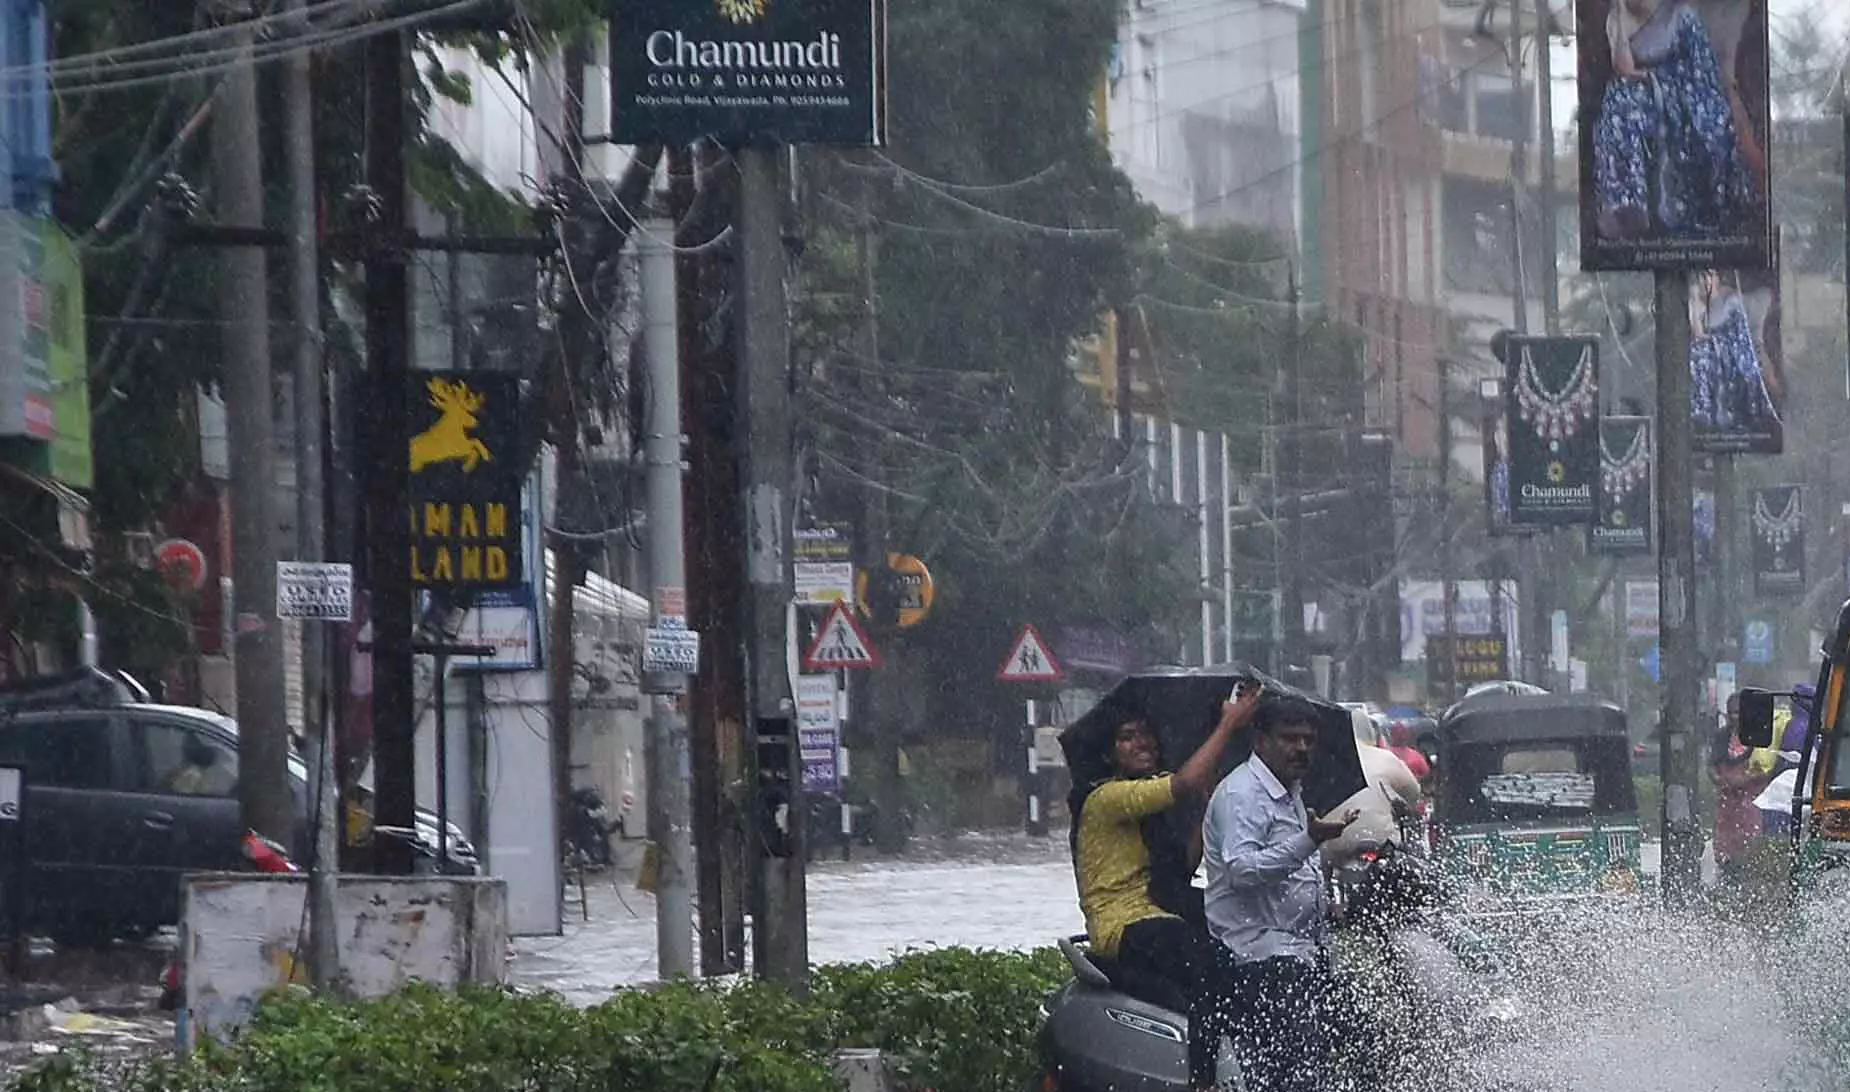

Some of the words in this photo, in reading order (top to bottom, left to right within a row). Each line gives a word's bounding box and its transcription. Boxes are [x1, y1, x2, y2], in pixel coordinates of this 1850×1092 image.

[647, 30, 840, 68] Chamundi
[647, 74, 701, 87] GOLD
[712, 74, 724, 87] &
[736, 74, 845, 88] DIAMONDS
[1521, 483, 1591, 498] Chamundi
[409, 502, 507, 537] MAN
[1593, 526, 1644, 537] Chamundi
[410, 544, 508, 582] LAND
